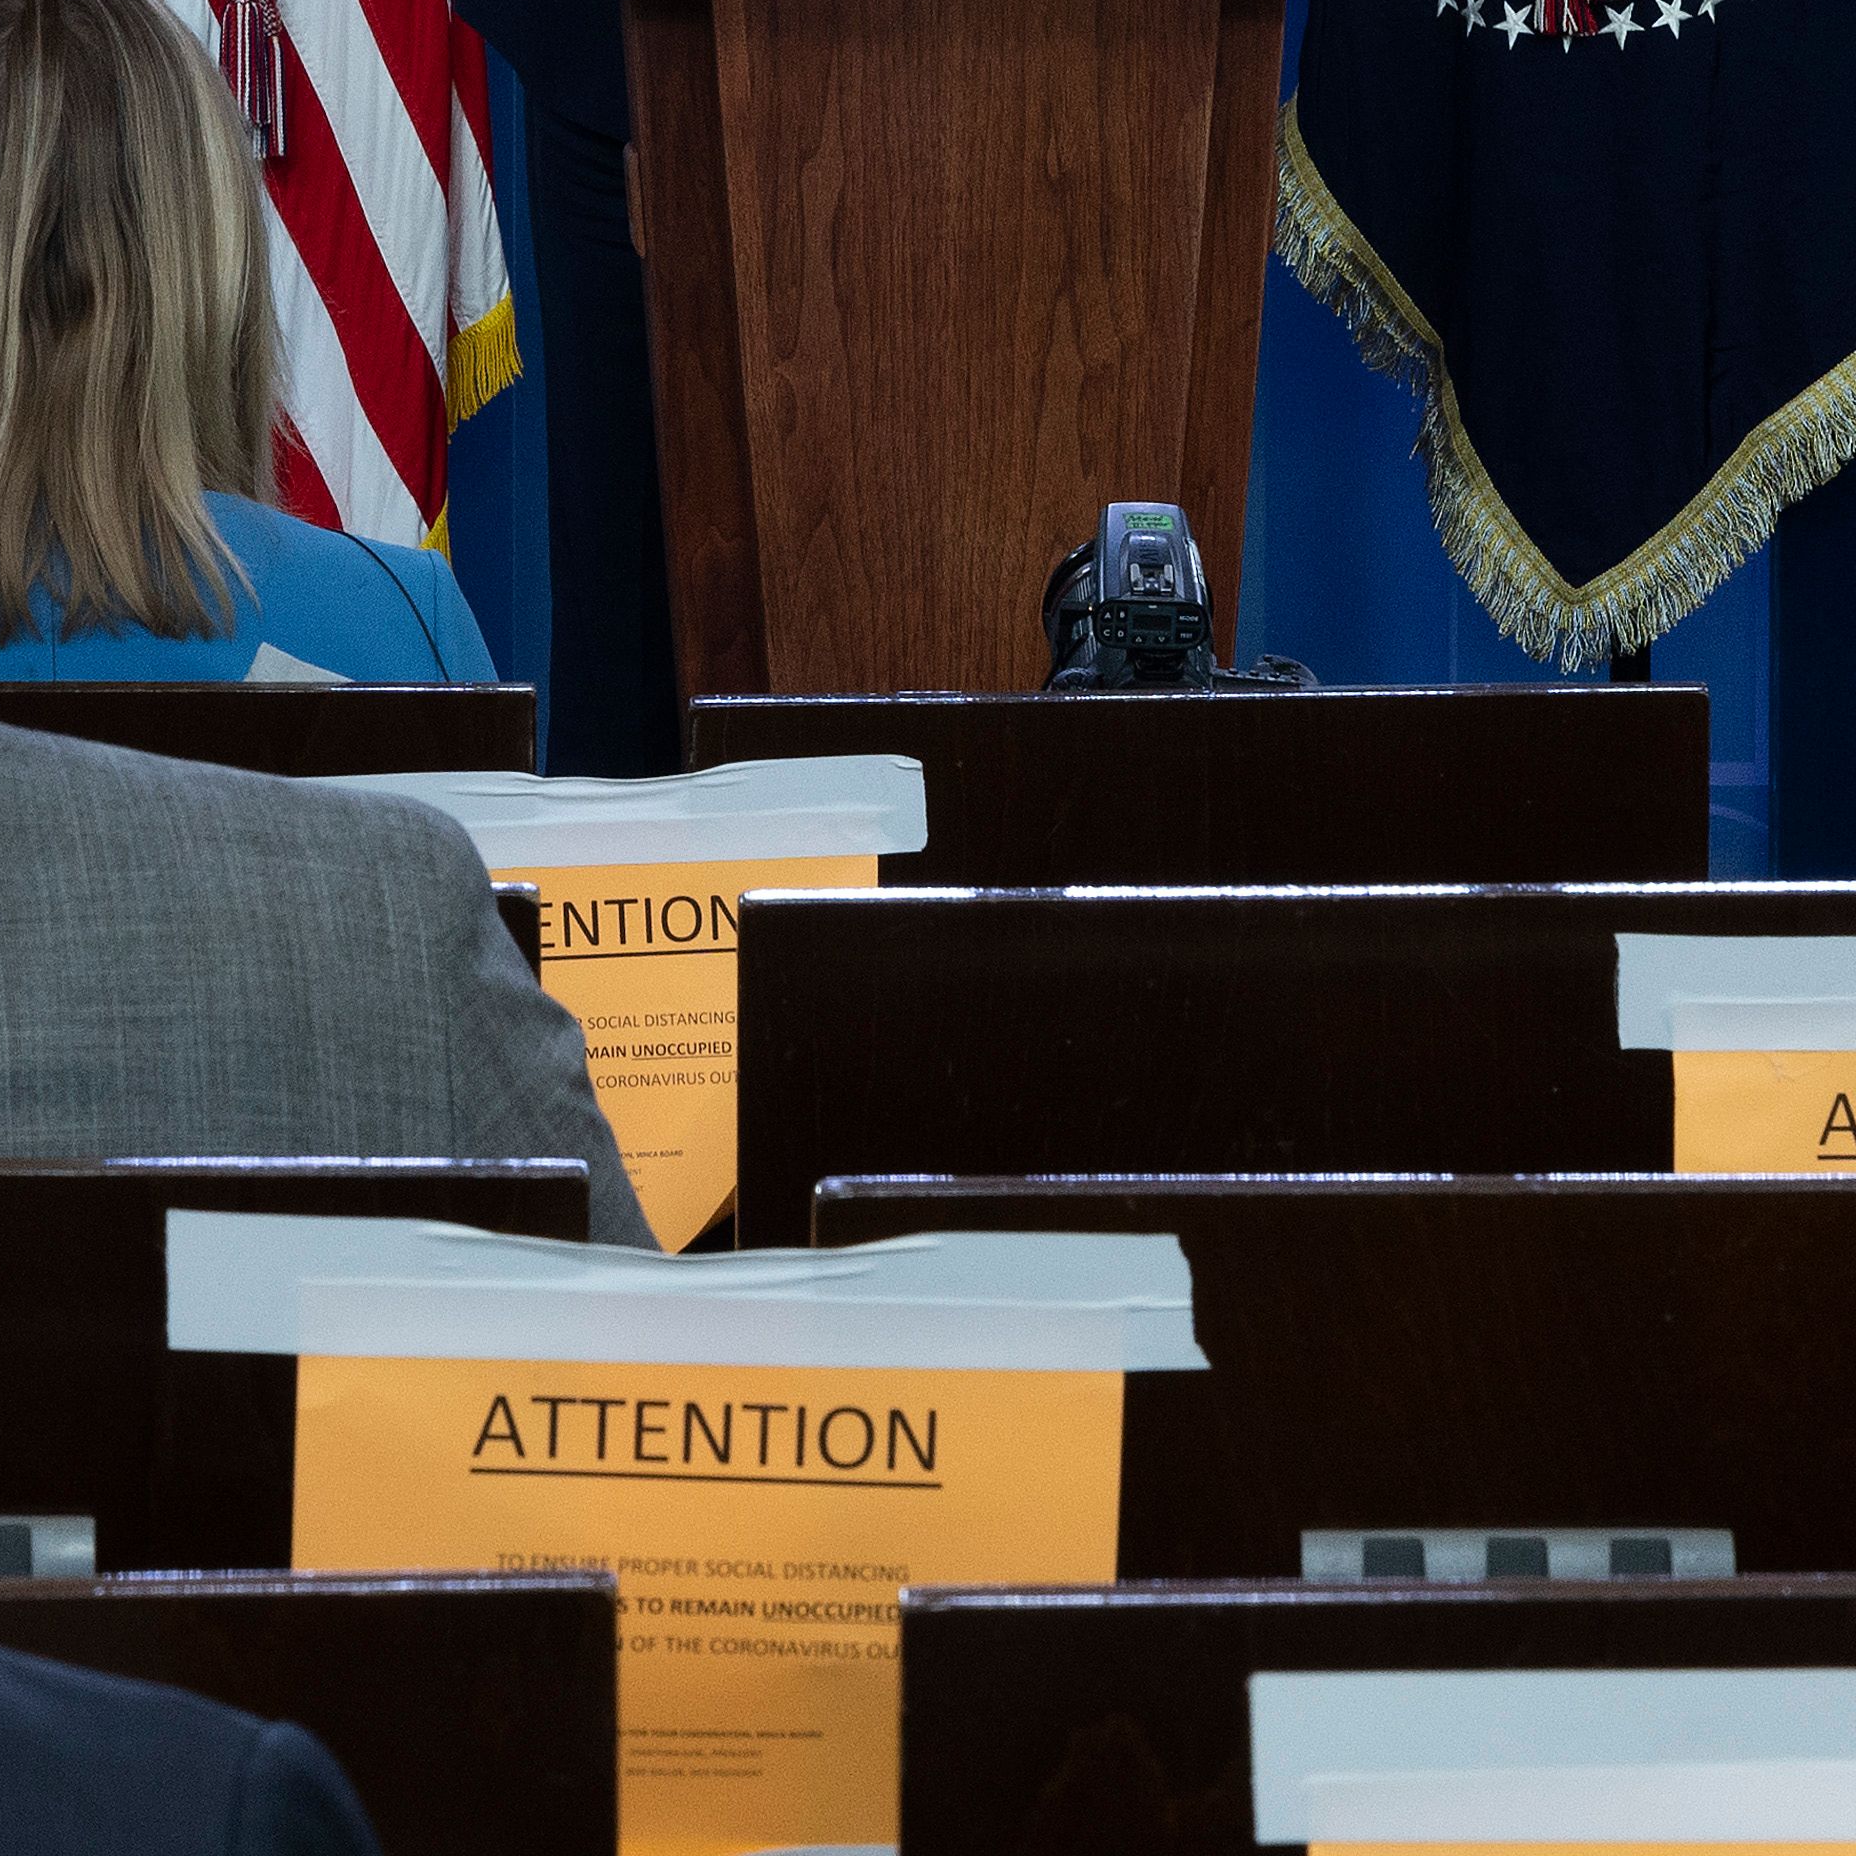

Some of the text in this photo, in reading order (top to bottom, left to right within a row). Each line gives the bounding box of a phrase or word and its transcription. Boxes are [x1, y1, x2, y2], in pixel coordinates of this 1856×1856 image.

[1103, 611, 1112, 620] A
[540, 895, 738, 949] NTION
[587, 1014, 640, 1030] SOCIAL
[644, 1011, 736, 1028] DISTANCING
[585, 1040, 733, 1060] MAIN UNOCCUPIED
[596, 1070, 706, 1089] CORONAVIRUS
[471, 1393, 939, 1473] ATTENTION
[619, 1556, 699, 1577] PROPER
[704, 1559, 774, 1581] SOCIAL
[783, 1561, 910, 1583] DISTANCING
[638, 1598, 665, 1616] TO
[670, 1598, 756, 1618] REMAIN
[761, 1600, 901, 1623] UNOCCUPIED
[631, 1635, 656, 1653] OF
[665, 1635, 702, 1654] THE
[708, 1638, 860, 1661] CORONAVIRUS
